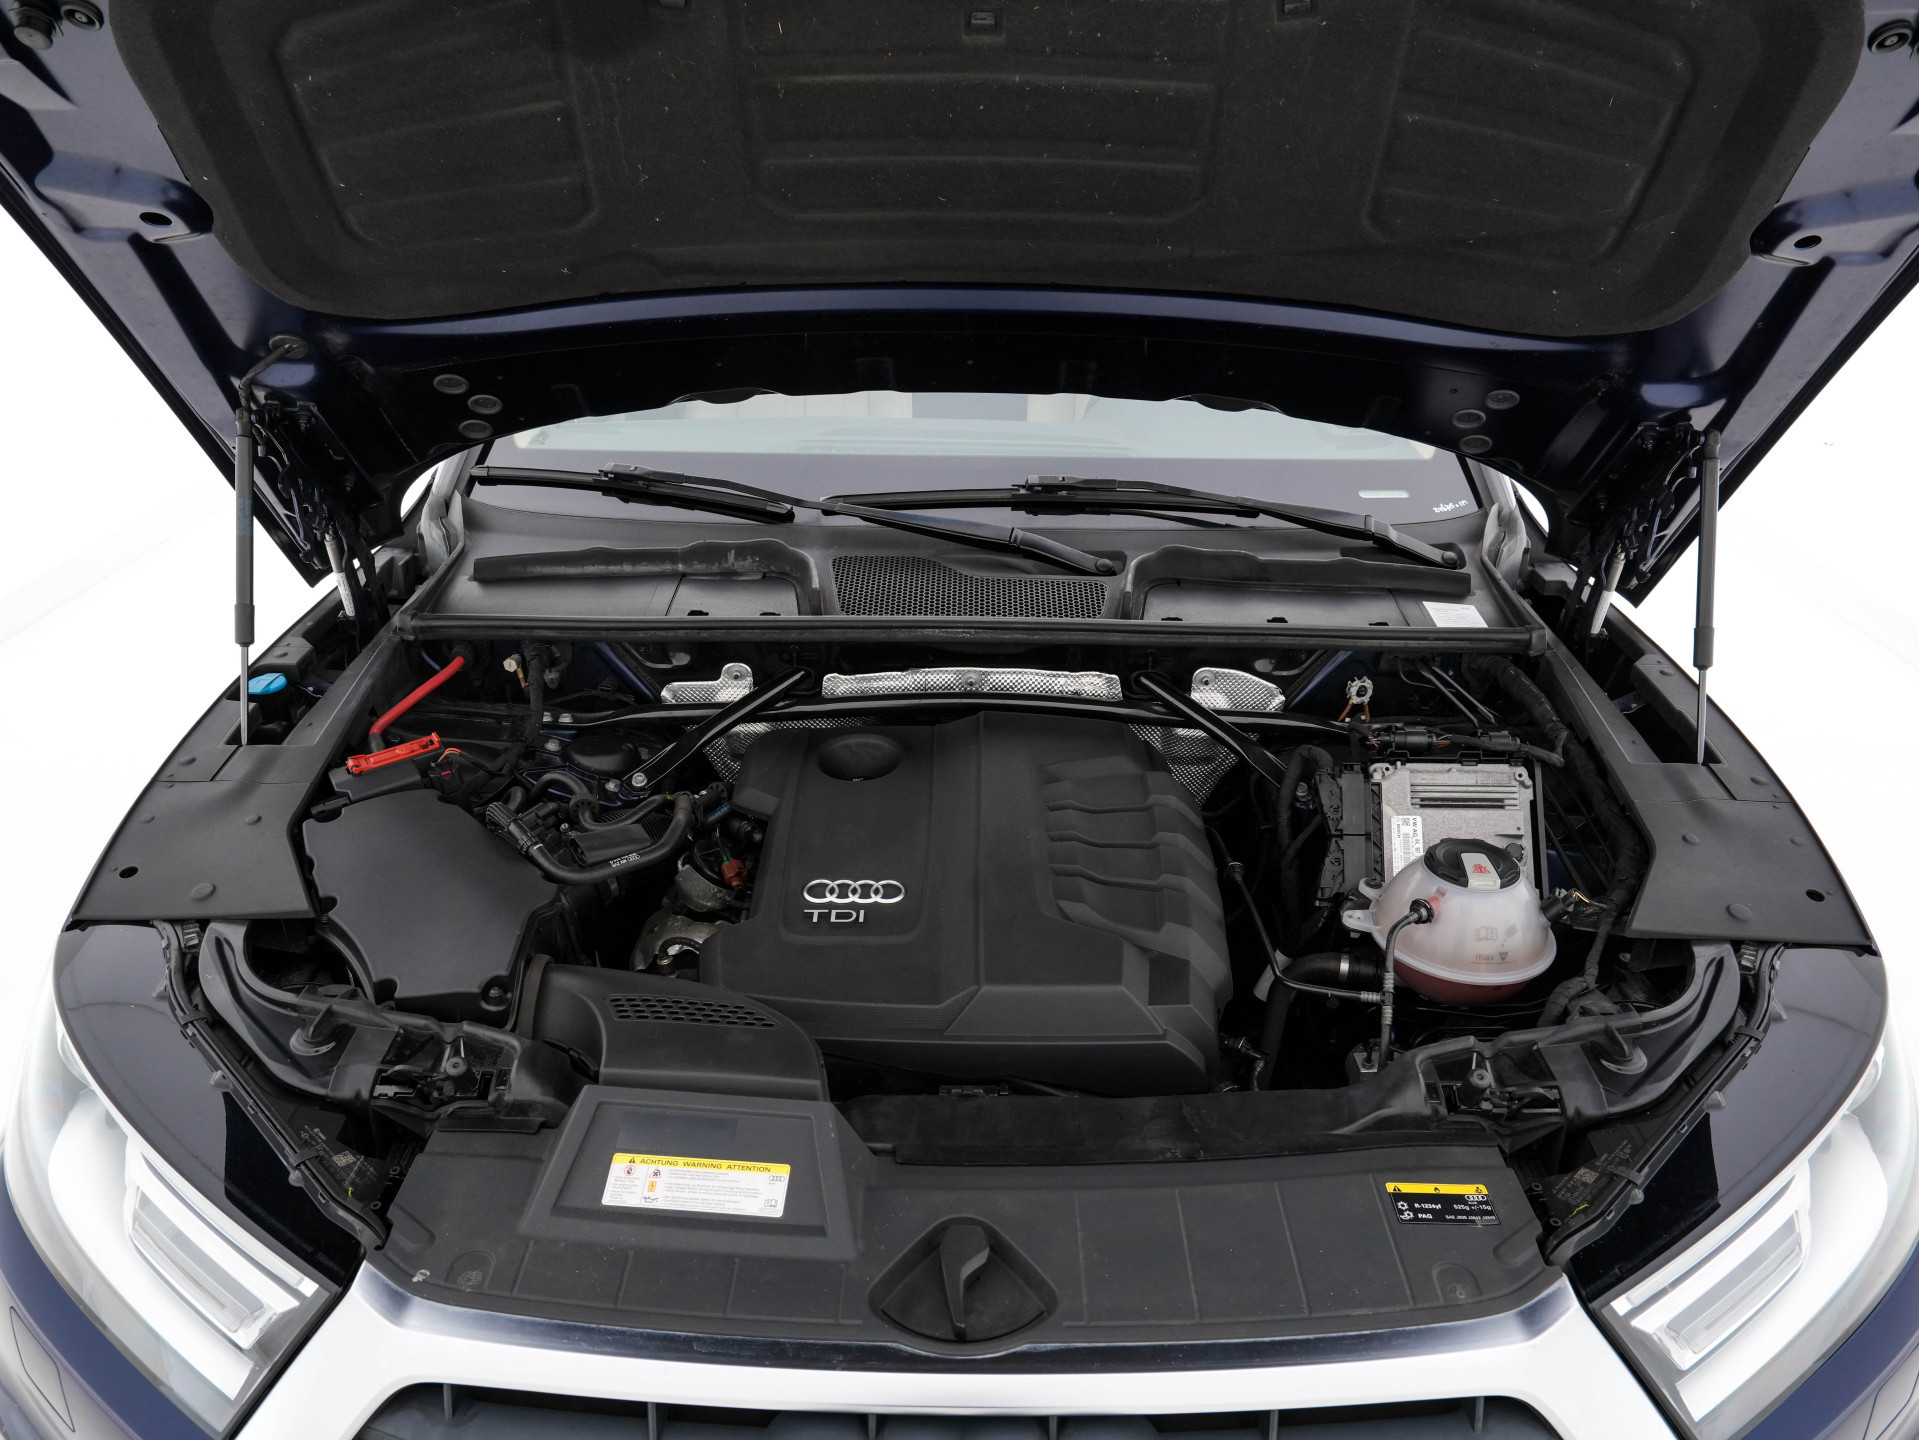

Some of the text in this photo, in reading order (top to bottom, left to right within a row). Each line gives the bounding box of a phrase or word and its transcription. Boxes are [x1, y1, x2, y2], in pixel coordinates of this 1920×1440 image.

[803, 909, 865, 923] TDI
[1475, 953, 1495, 961] max
[639, 1157, 772, 1173] ACHTUNG WARNING ATTENTION
